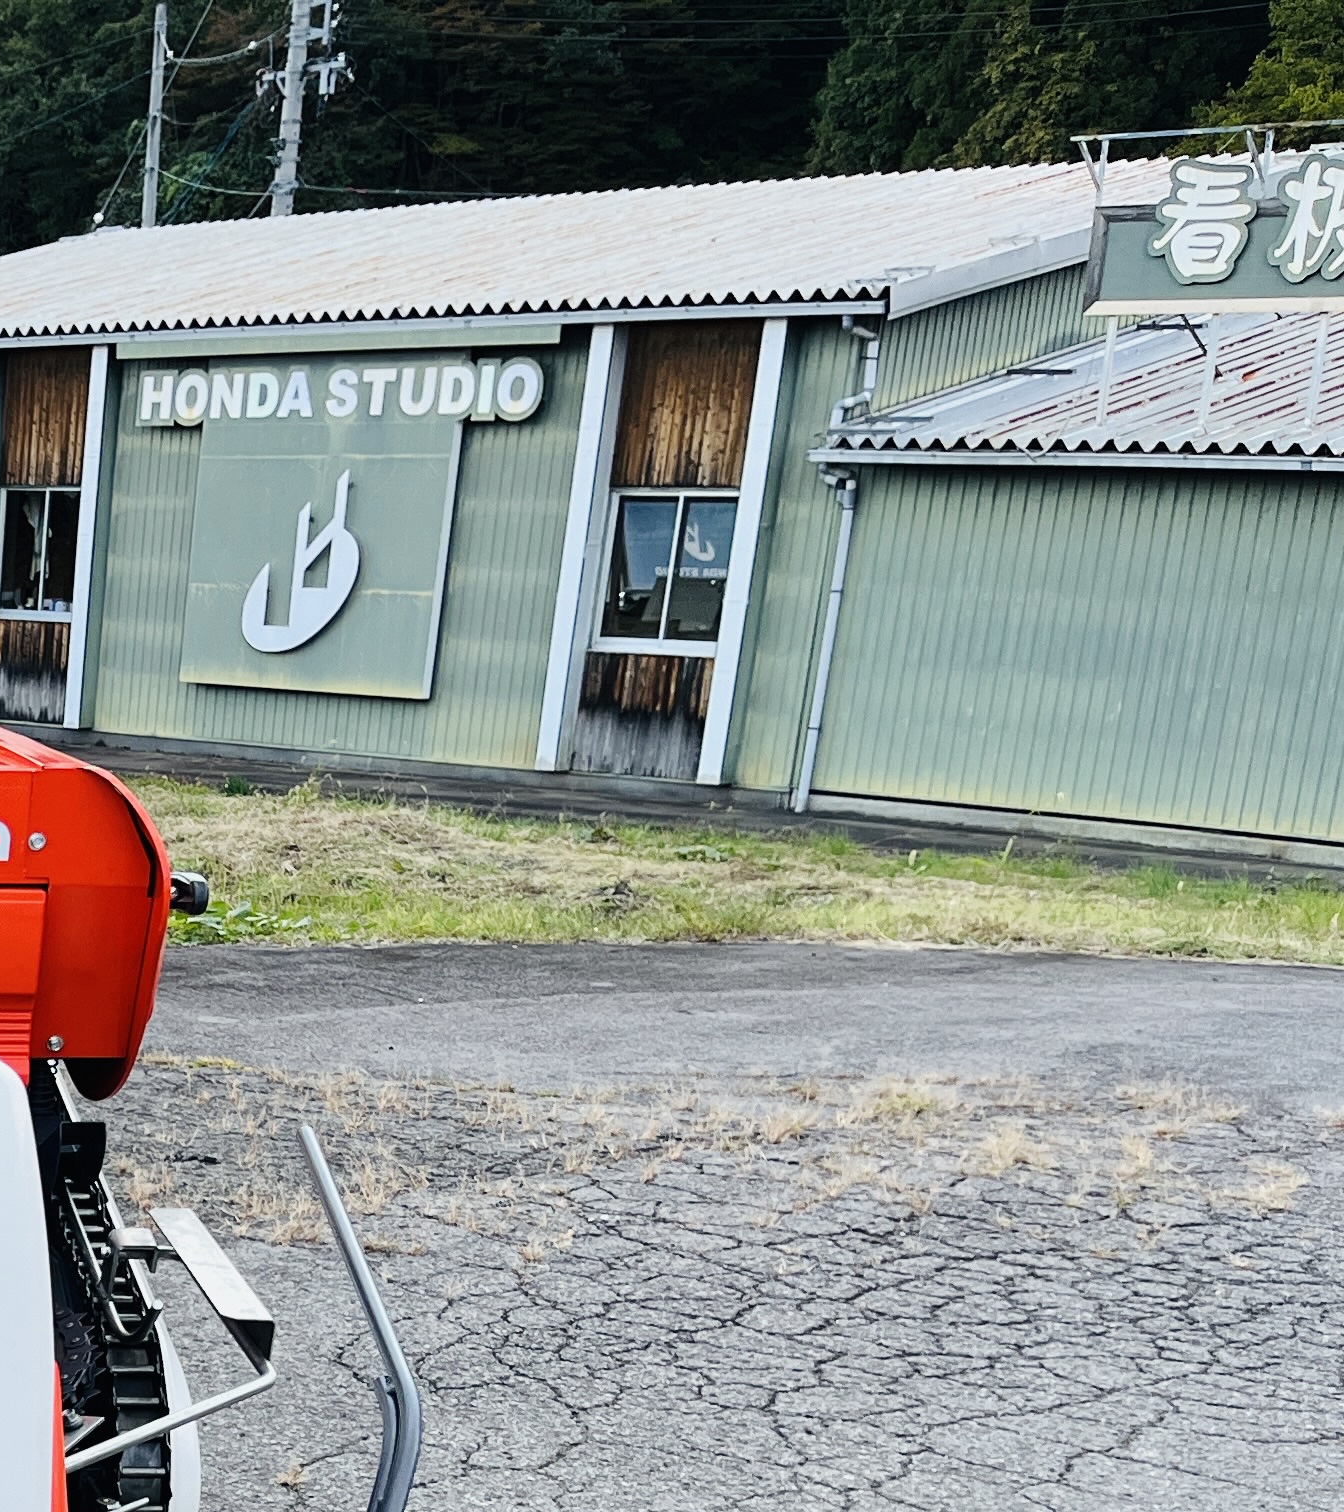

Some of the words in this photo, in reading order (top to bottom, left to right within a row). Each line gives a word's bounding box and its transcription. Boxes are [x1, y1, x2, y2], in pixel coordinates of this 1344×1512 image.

[1152, 160, 1344, 280] 看板
[139, 371, 314, 421] HONDA
[325, 362, 541, 418] STUDIO
